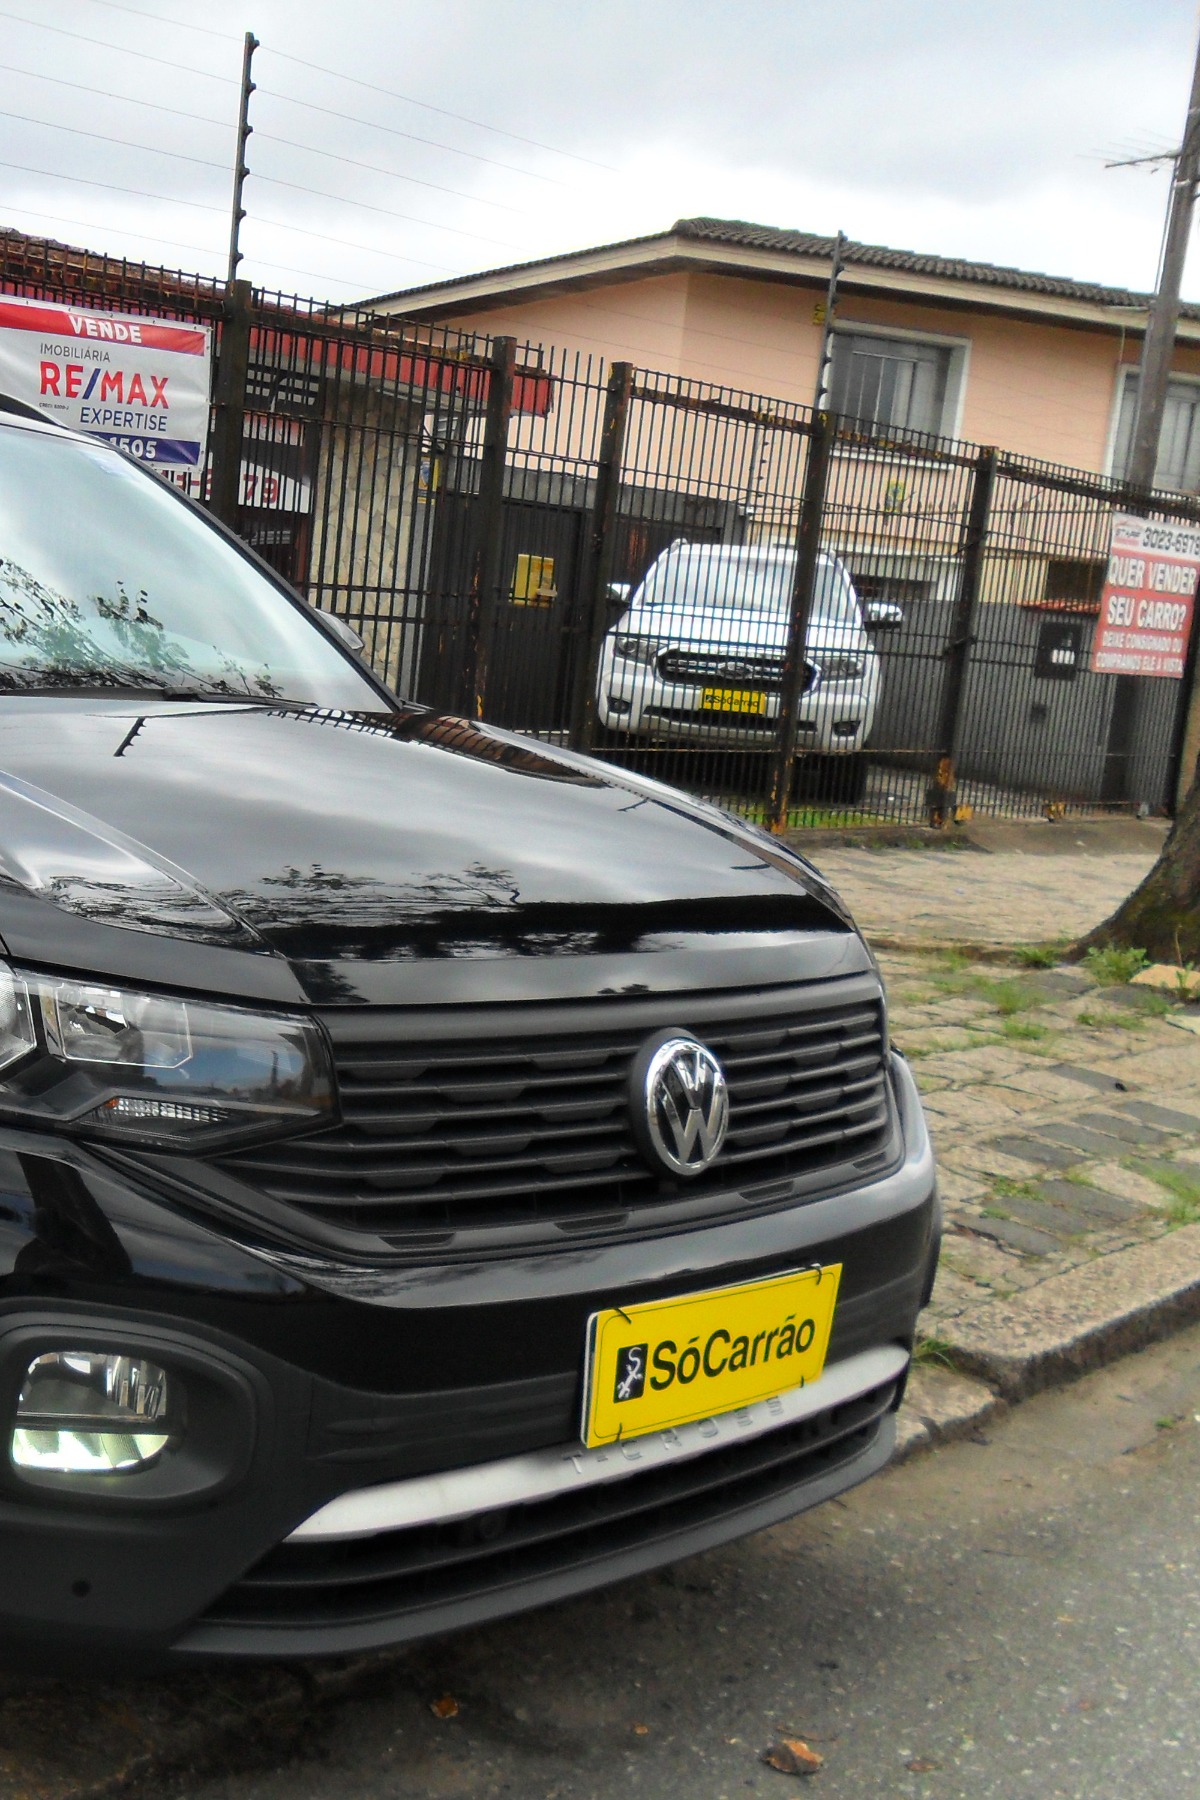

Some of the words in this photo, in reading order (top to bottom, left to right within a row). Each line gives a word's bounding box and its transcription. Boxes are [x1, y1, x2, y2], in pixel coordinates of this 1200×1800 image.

[68, 315, 142, 344] VENDE
[40, 343, 111, 362] IMOBILIÁRIA
[40, 361, 169, 409] RE/MAX
[80, 407, 168, 431] EXPERTISE
[1109, 555, 1145, 588] QUER
[1149, 562, 1197, 596] VENDER
[1107, 596, 1135, 627] SEU
[1137, 600, 1187, 632] CARRO?
[650, 1313, 815, 1391] SóCarrão
